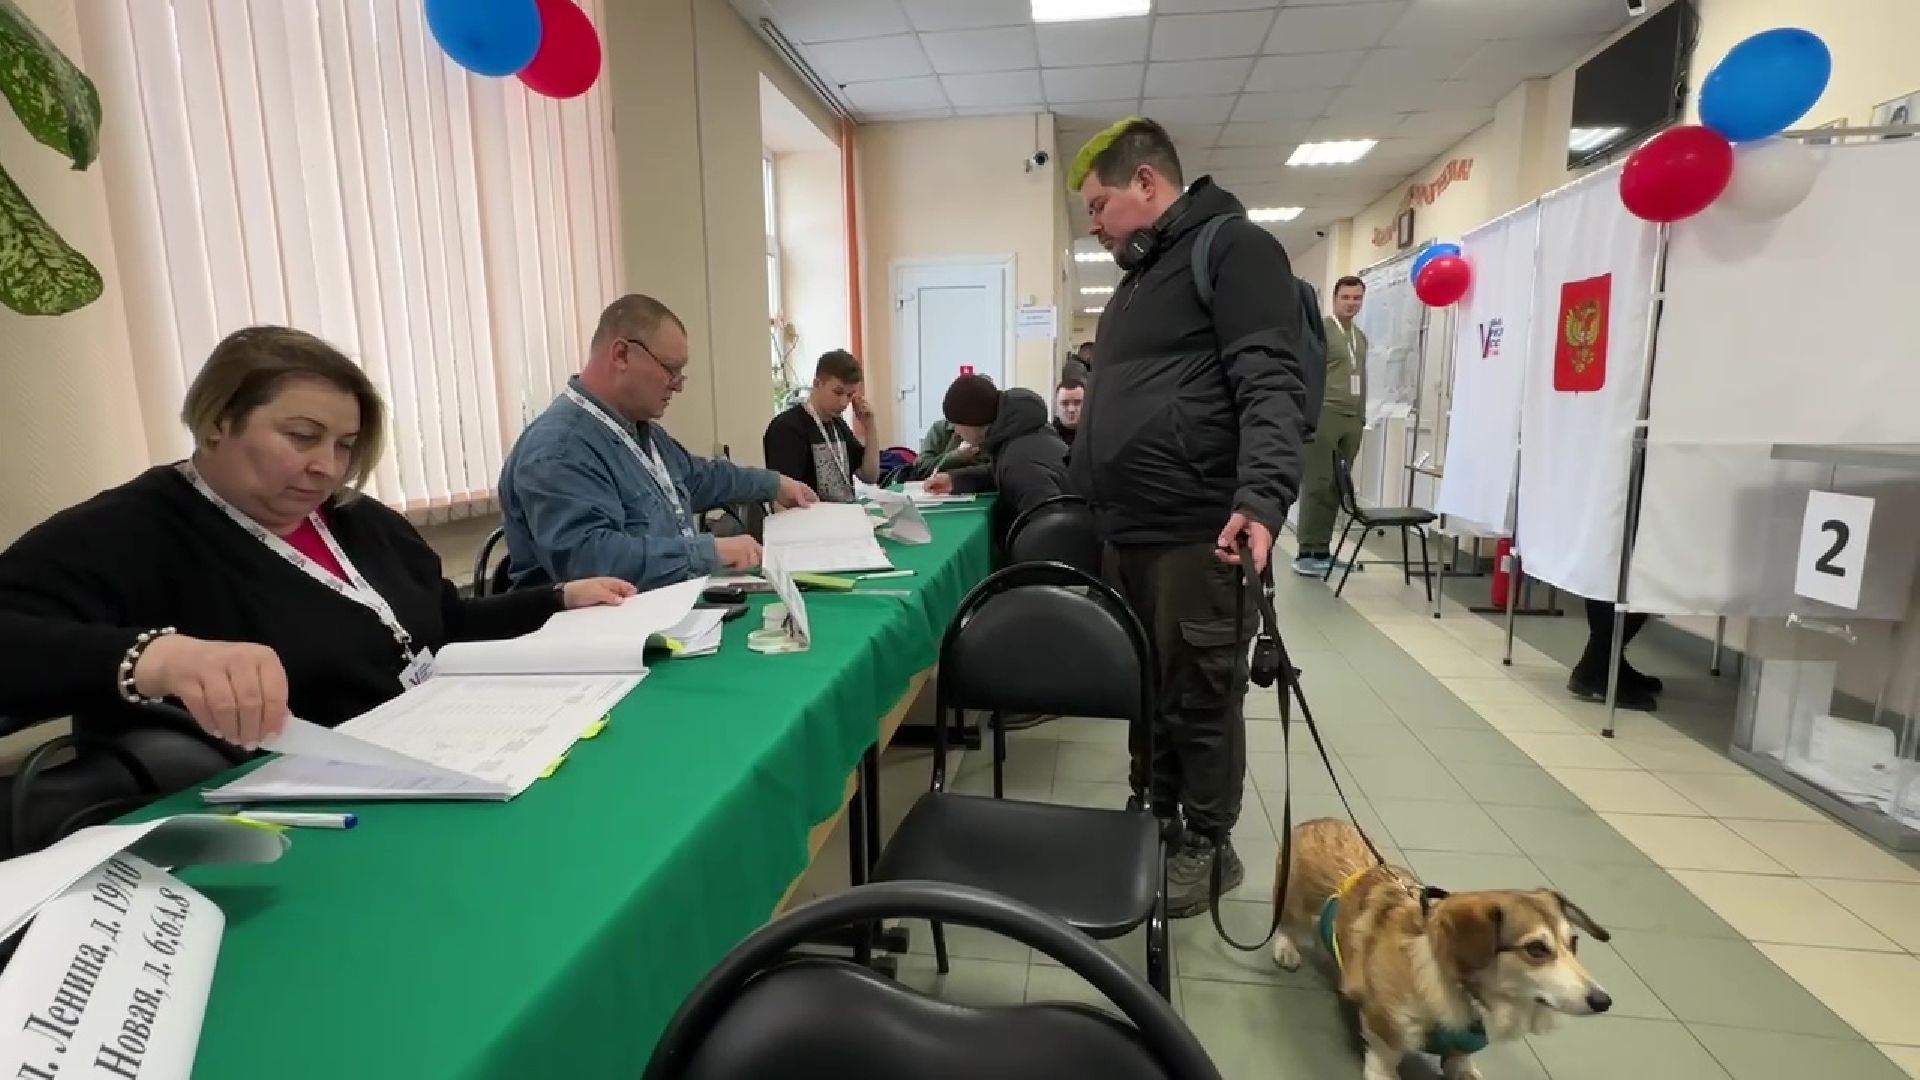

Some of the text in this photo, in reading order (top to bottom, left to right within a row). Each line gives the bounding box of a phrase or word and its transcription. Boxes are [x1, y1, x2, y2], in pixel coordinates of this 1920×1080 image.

[1815, 519, 1850, 577] 2
[93, 857, 142, 915] 19/10
[91, 918, 121, 942] д.
[23, 943, 119, 1053] Ленина,
[94, 987, 171, 1080] Новая,
[143, 962, 174, 985] д.
